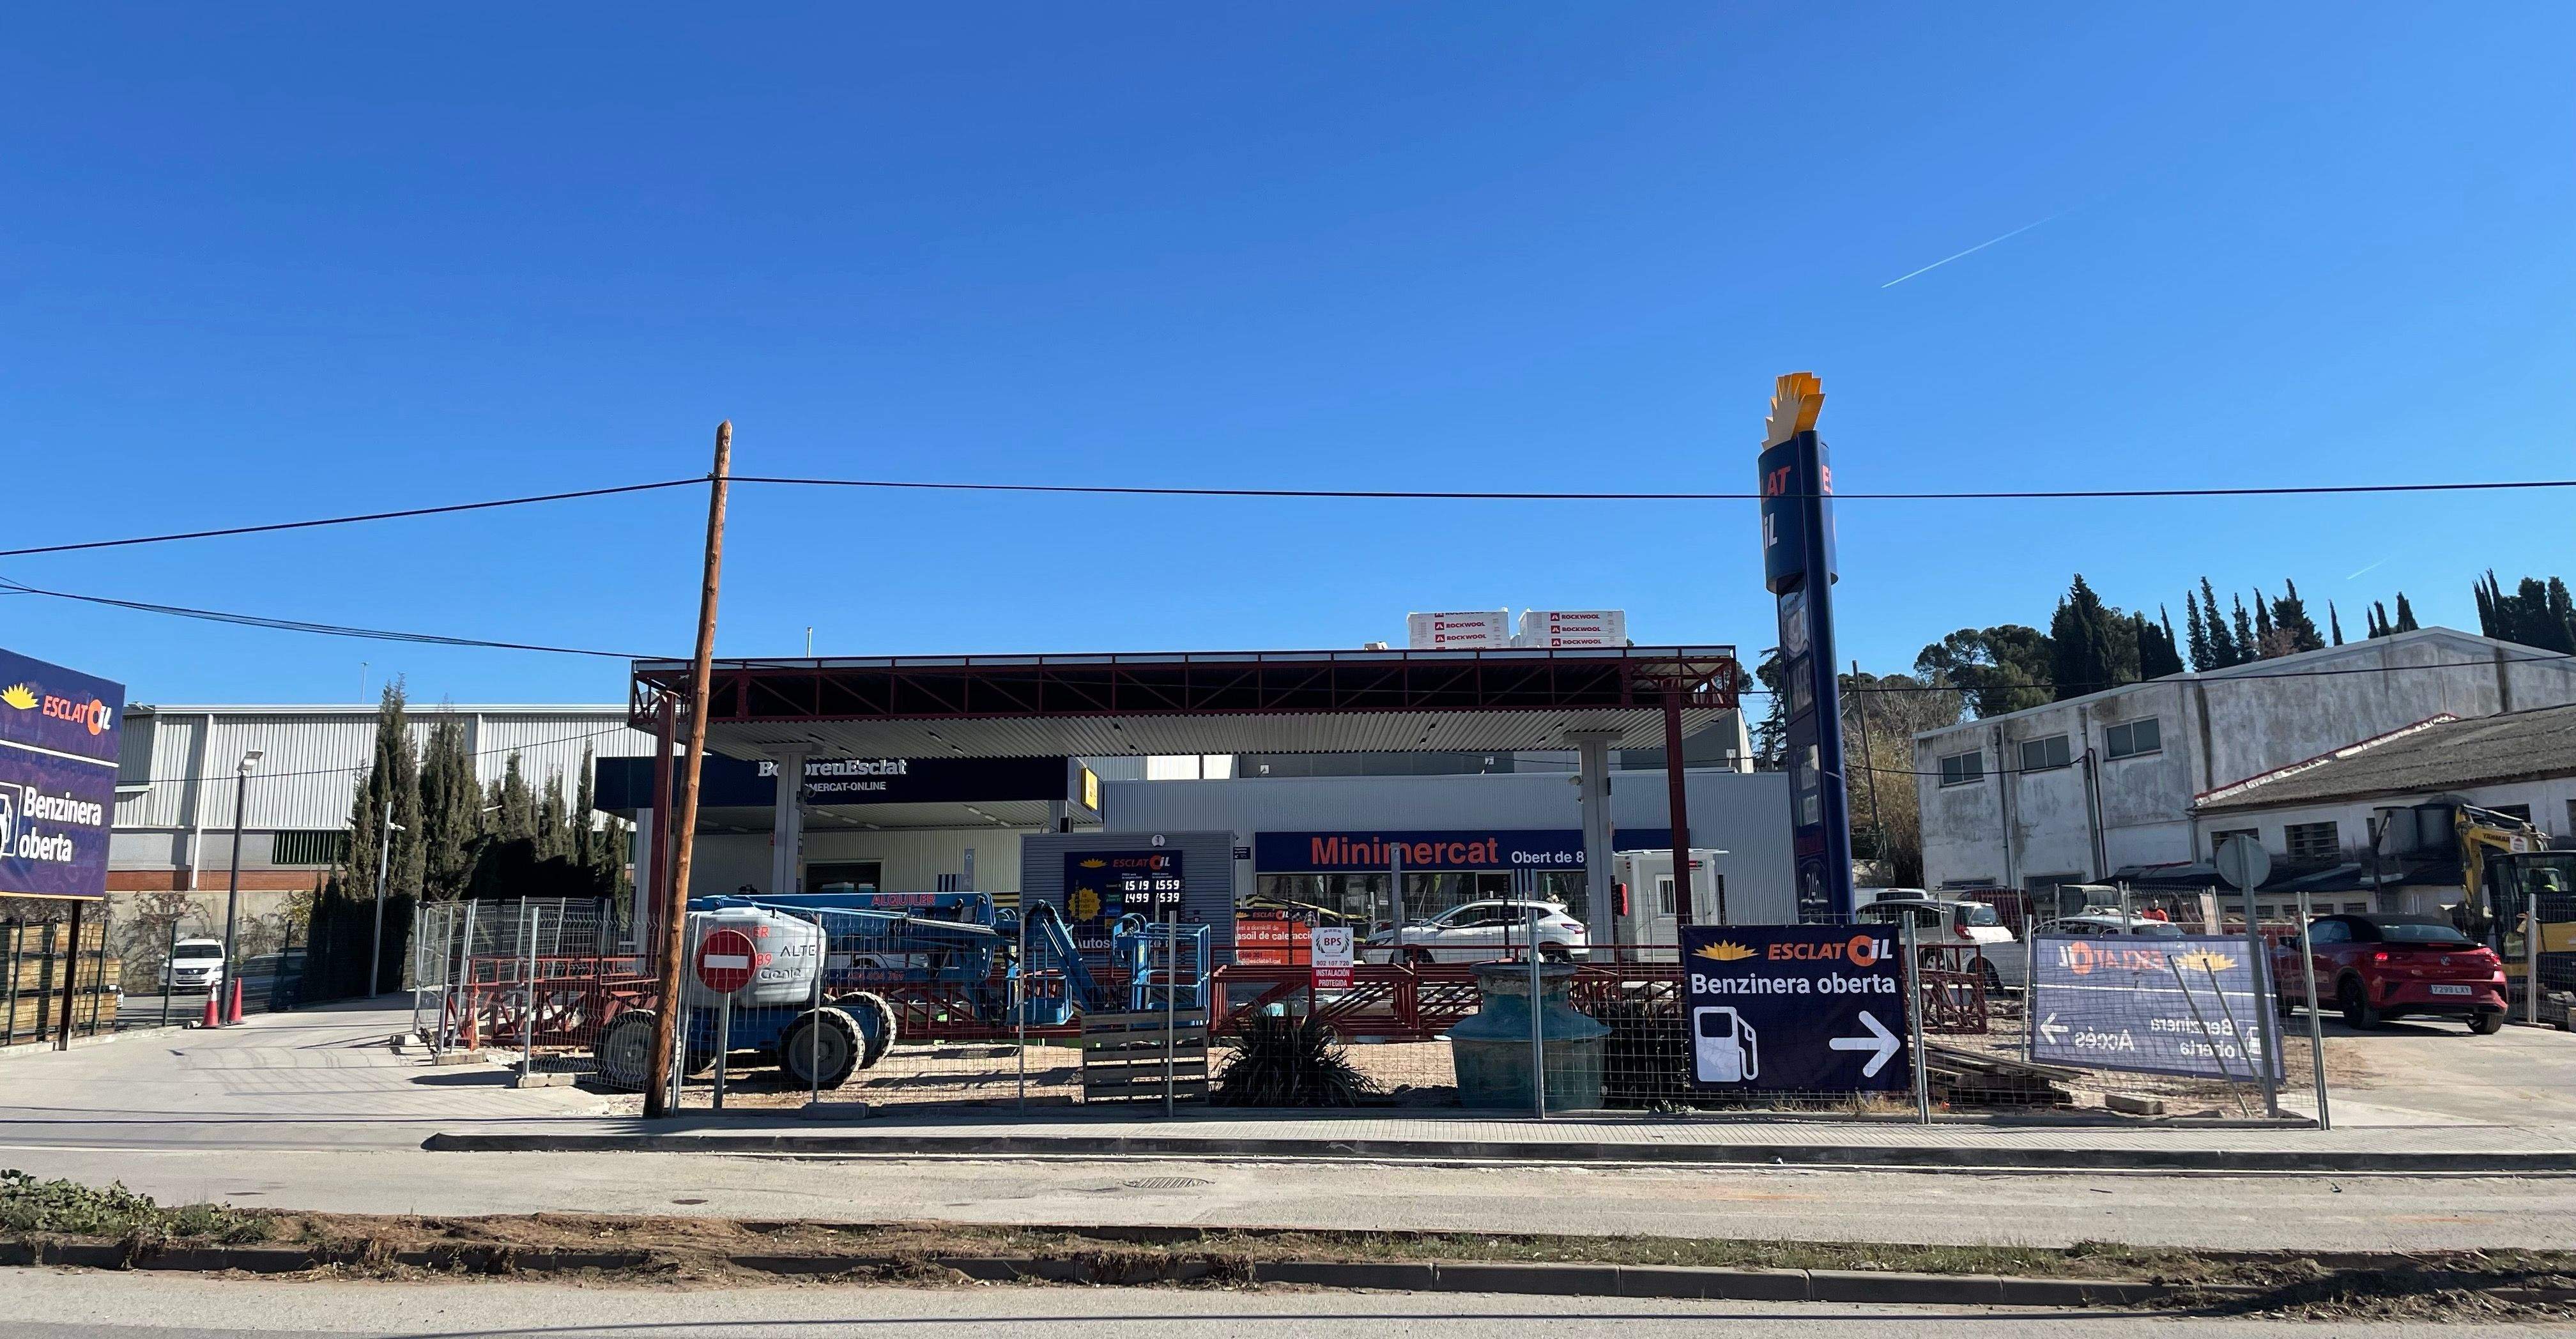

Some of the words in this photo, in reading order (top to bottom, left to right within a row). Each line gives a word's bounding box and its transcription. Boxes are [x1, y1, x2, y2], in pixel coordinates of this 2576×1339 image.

[24, 786, 102, 826] Benzinera
[19, 827, 73, 862] oberta
[1311, 837, 1499, 864] Minimercat
[1512, 851, 1551, 864] Obert
[1554, 850, 1574, 863] de
[1576, 851, 1584, 862] 8
[871, 894, 936, 907] ALQUILER
[1259, 931, 1269, 940] de
[1324, 938, 1341, 946] BPS
[1316, 968, 1350, 976] INSTALACIÓN
[1691, 974, 1811, 994] Benzinera
[1818, 972, 1896, 993] oberta
